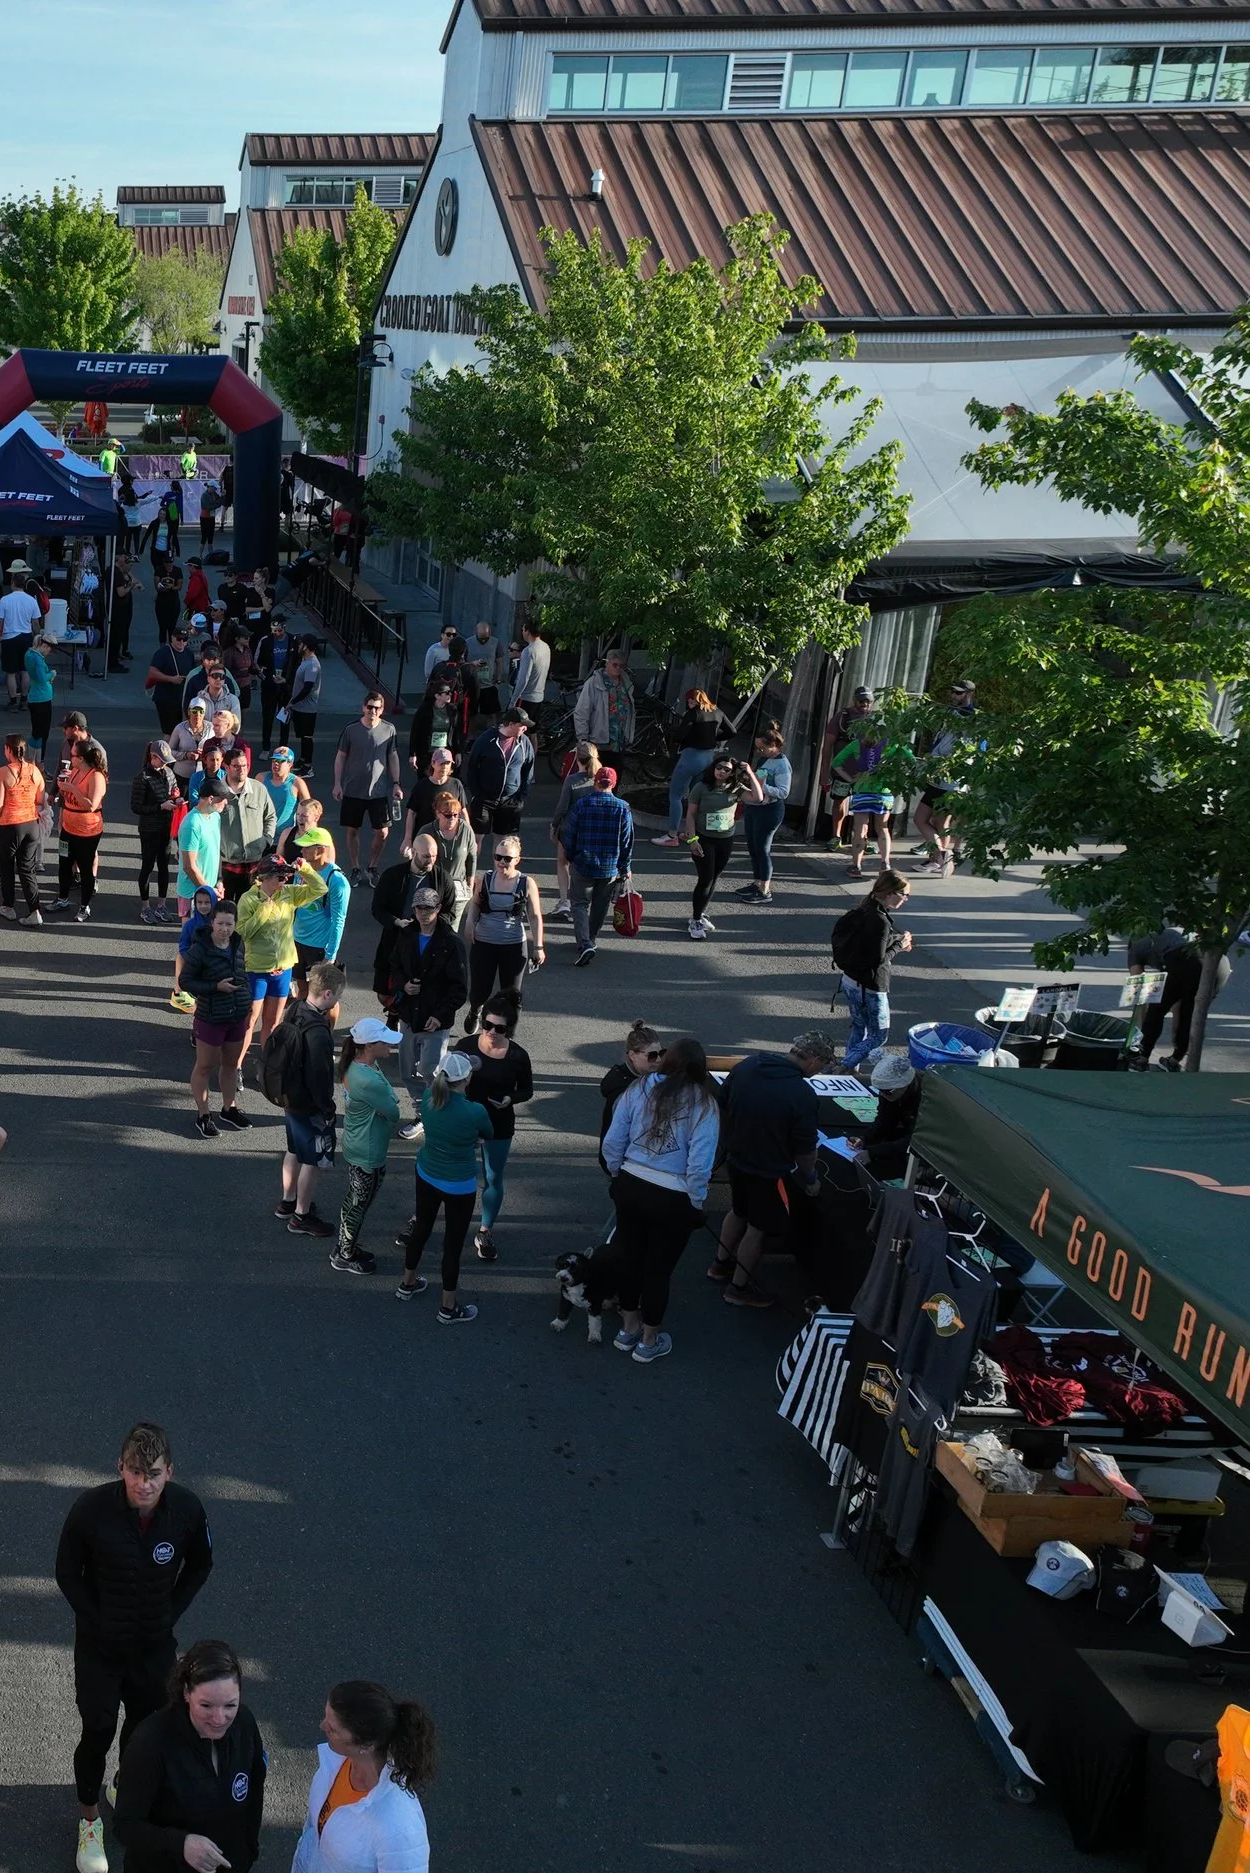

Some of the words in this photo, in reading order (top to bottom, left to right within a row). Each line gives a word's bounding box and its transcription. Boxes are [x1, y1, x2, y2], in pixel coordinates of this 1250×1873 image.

[379, 295, 421, 332] CROOKED
[424, 295, 452, 333] GOAT
[76, 360, 125, 373] FLEET
[128, 362, 169, 374] FEET
[17, 492, 54, 502] FEET
[810, 1078, 862, 1093] INFO
[1030, 1187, 1049, 1238] A
[1067, 1215, 1152, 1322] GOOD
[1173, 1301, 1250, 1409] RUN
